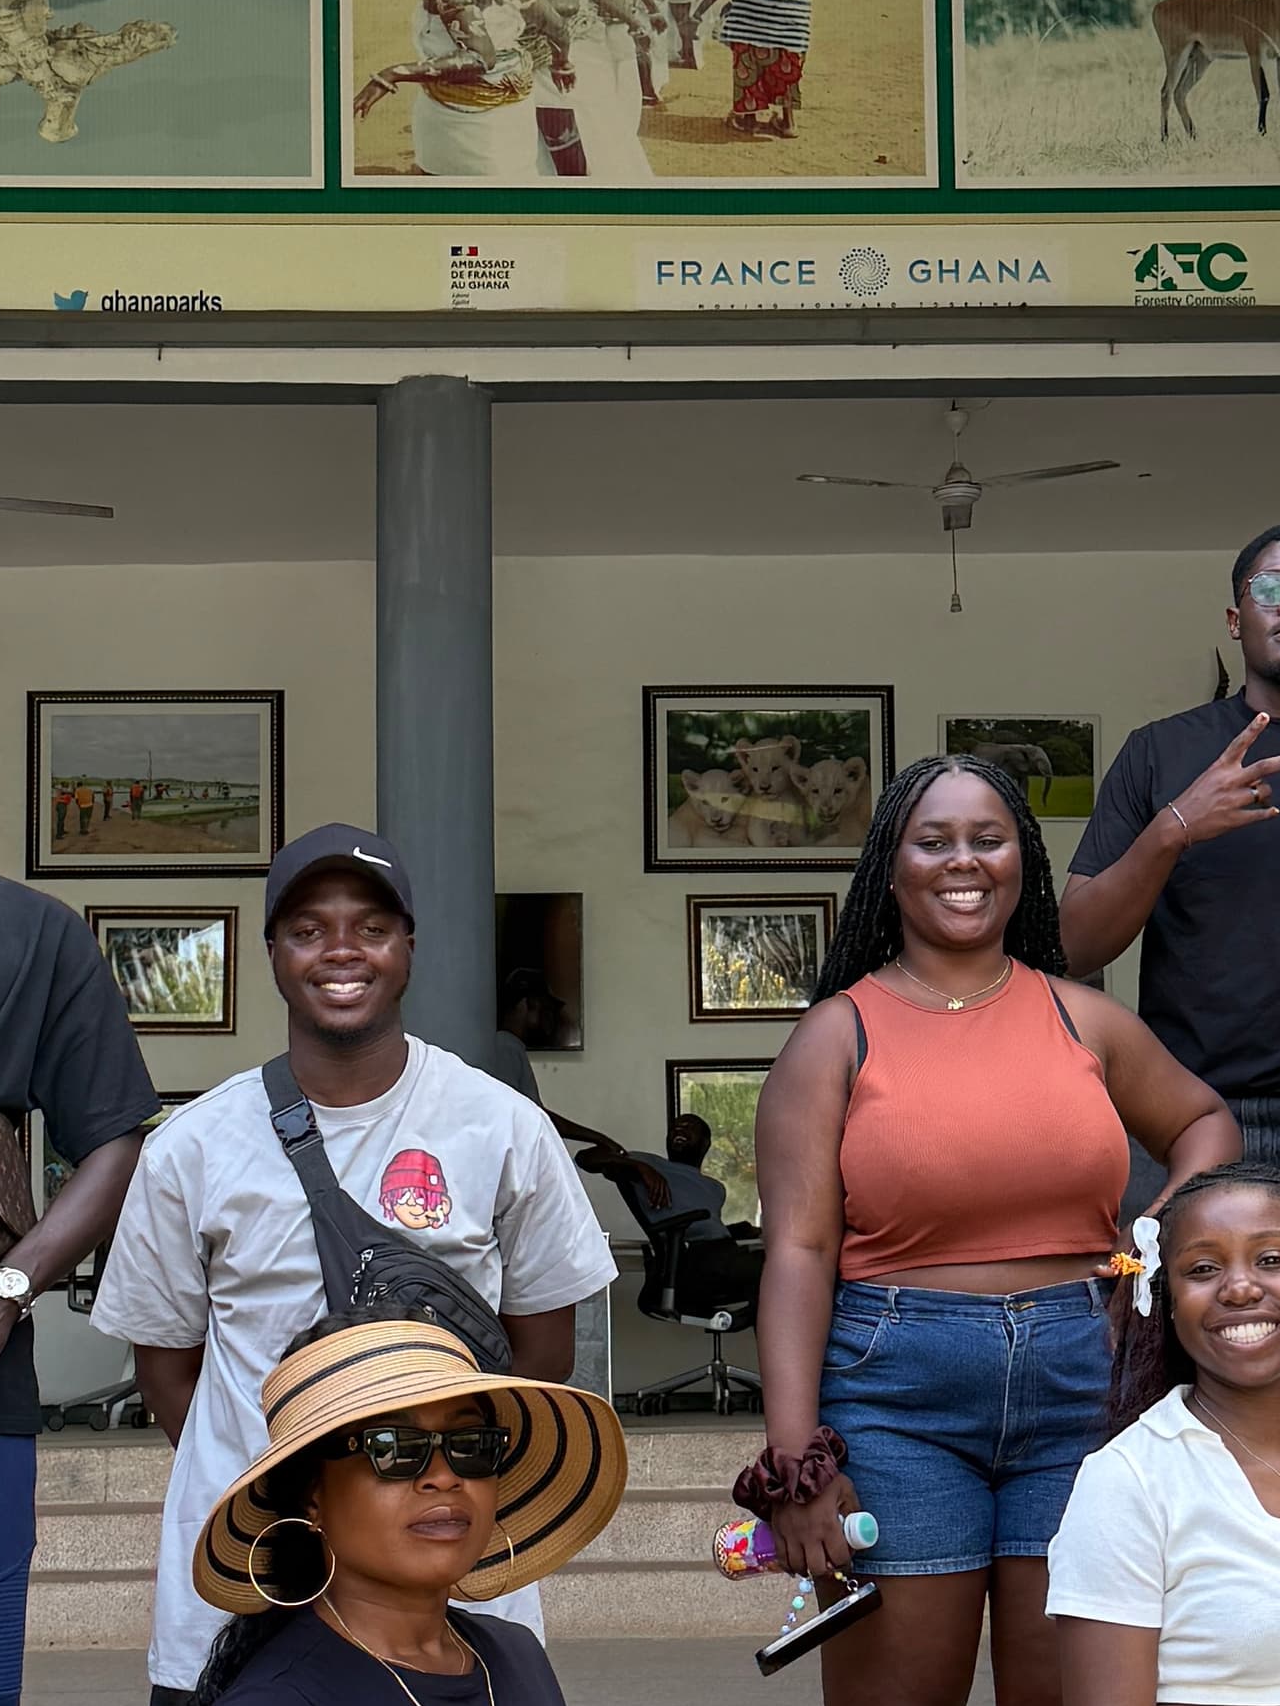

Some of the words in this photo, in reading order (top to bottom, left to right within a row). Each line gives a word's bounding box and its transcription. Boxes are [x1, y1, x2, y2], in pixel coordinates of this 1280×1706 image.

[451, 260, 516, 269] AMBASSADE
[451, 270, 465, 279] DE
[467, 270, 511, 279] FRANCE
[655, 259, 816, 286] FRANCE
[907, 258, 1052, 285] GHANA
[451, 280, 466, 290] AU
[469, 280, 510, 290] GHANA
[101, 289, 222, 312] ghanaparks
[1185, 293, 1256, 307] Commission
